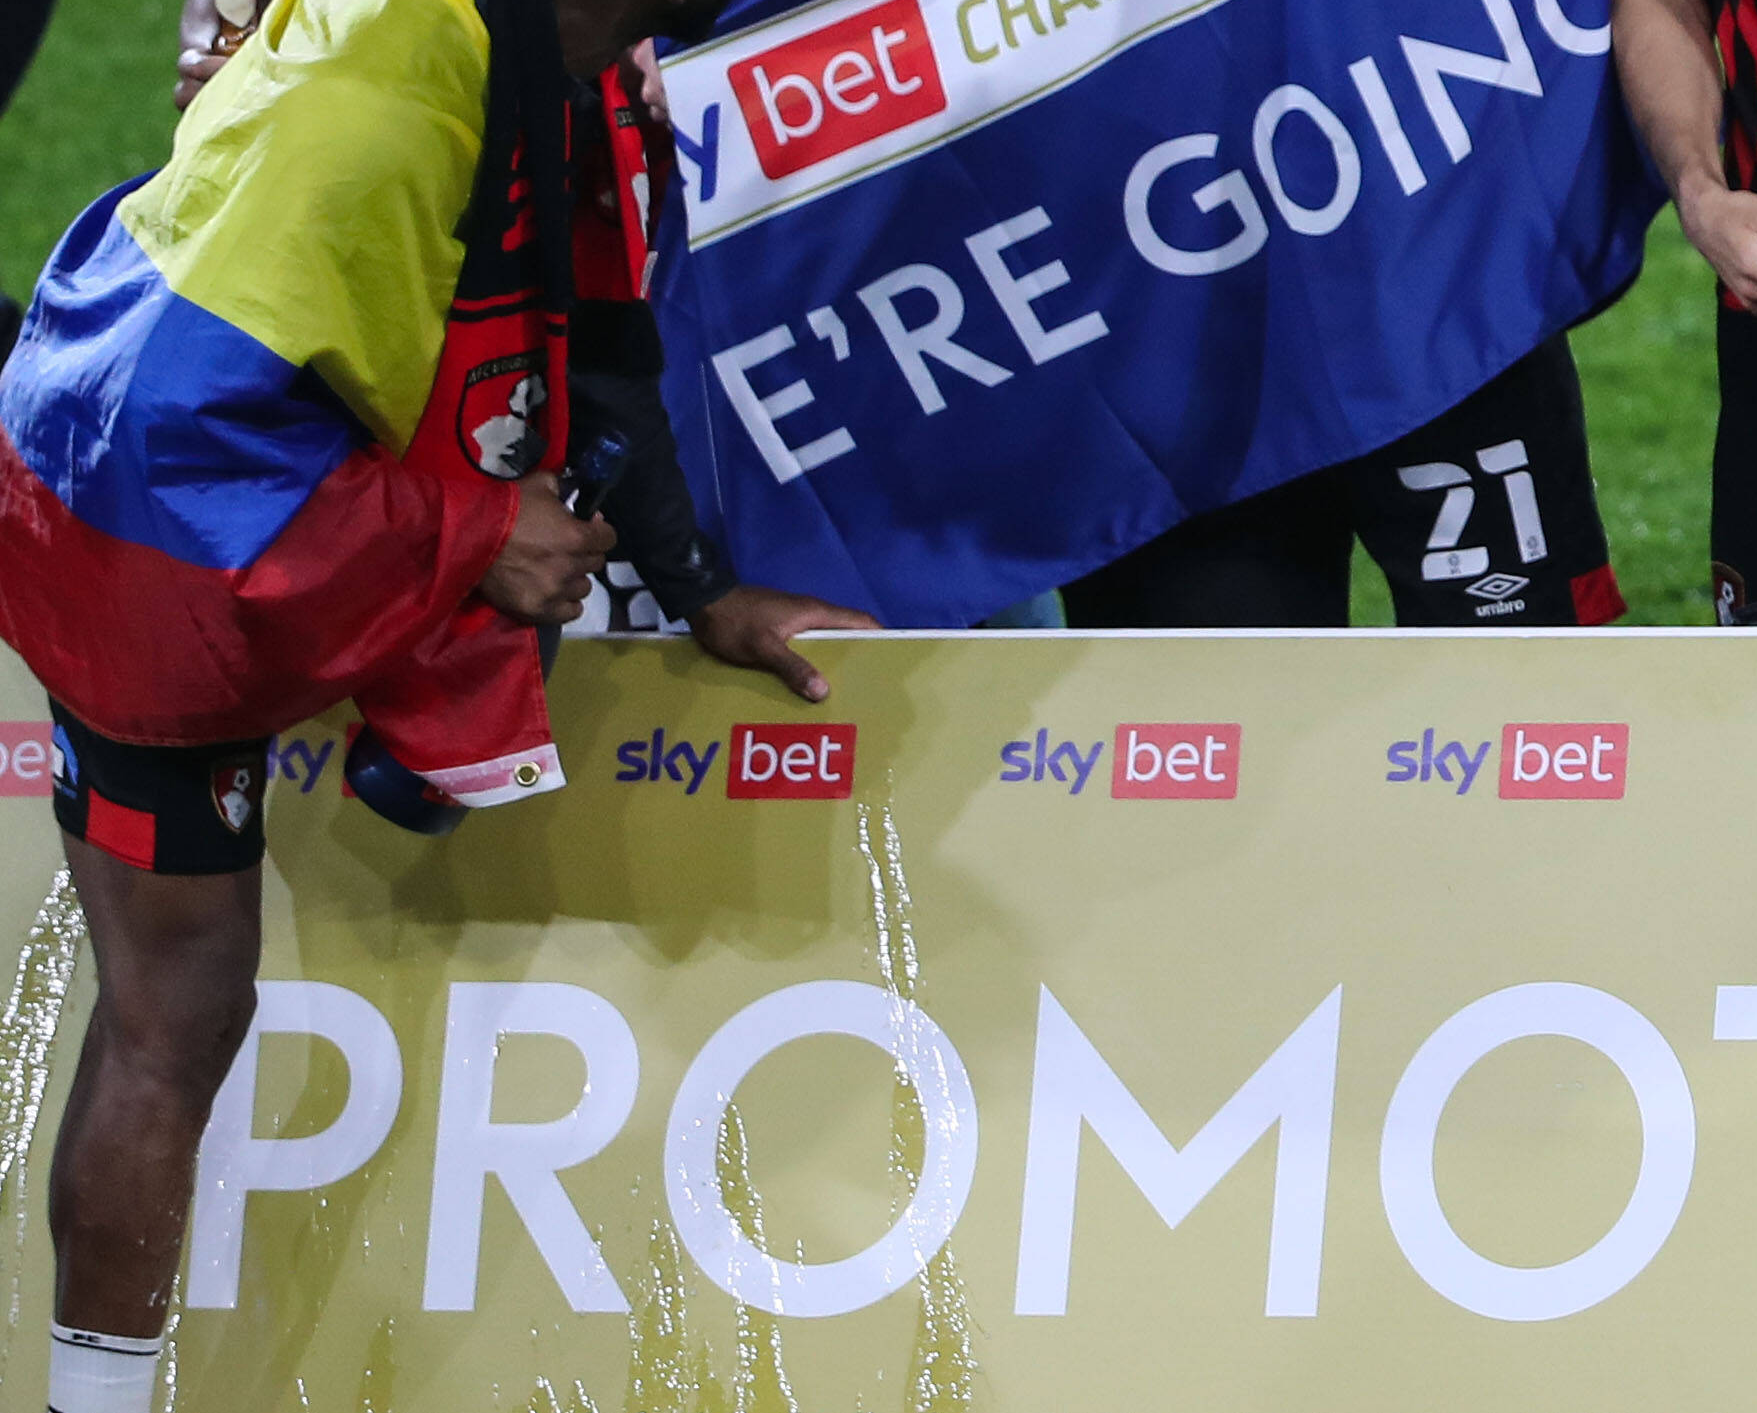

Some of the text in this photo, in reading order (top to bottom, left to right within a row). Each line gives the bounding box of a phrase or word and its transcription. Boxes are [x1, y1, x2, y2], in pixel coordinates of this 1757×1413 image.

[752, 25, 923, 145] bet
[711, 205, 1110, 485] E'RE
[1398, 438, 1548, 581] 21
[1475, 599, 1526, 618] umbro
[266, 733, 336, 794] ky
[617, 729, 842, 794] sky bet
[1000, 728, 1227, 794] sky bet
[1386, 728, 1615, 795] sky bet
